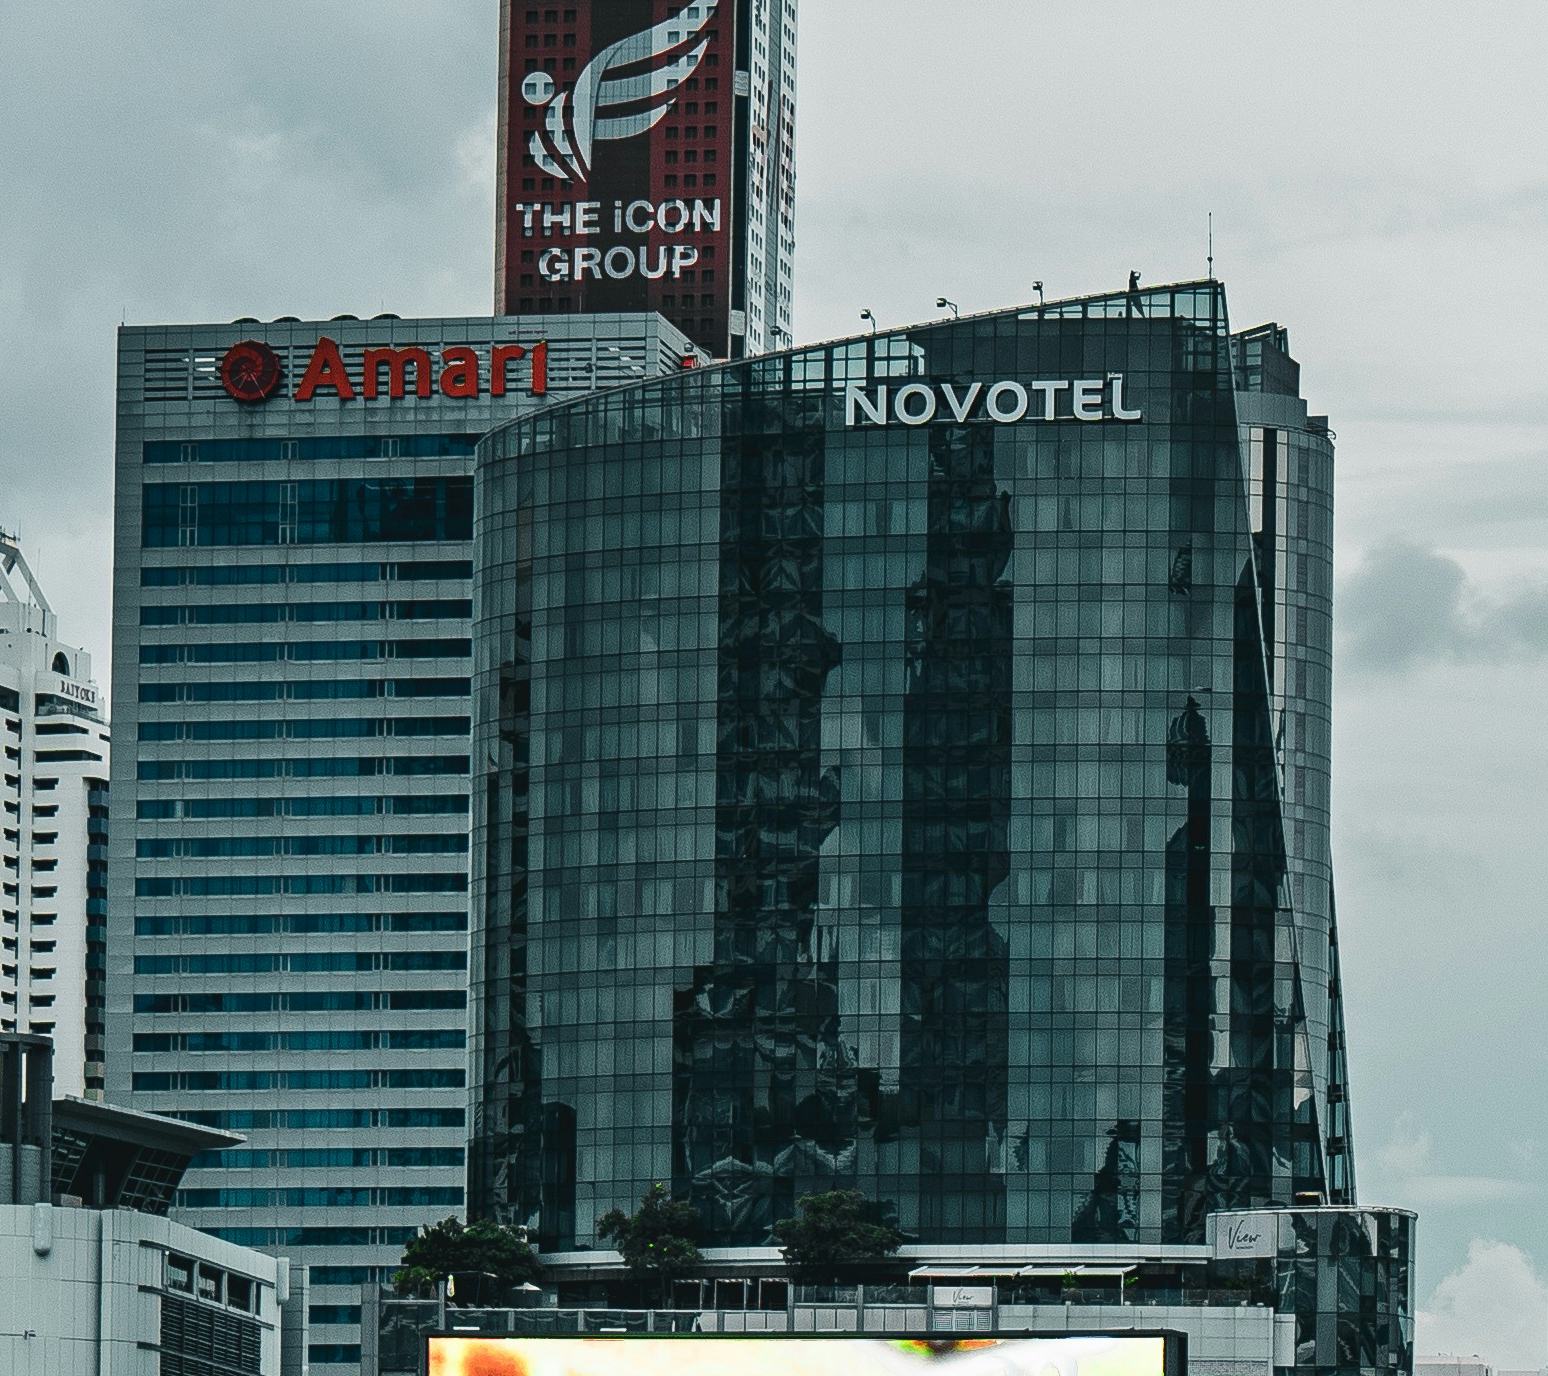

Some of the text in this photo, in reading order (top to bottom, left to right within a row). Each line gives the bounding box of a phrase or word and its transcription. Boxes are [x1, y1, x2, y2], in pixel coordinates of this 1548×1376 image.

[516, 201, 601, 237] THE
[539, 246, 699, 281] GROUP
[295, 336, 548, 399] Amari
[846, 380, 1141, 426] NOVOTEL
[60, 680, 96, 703] BAIYOKE
